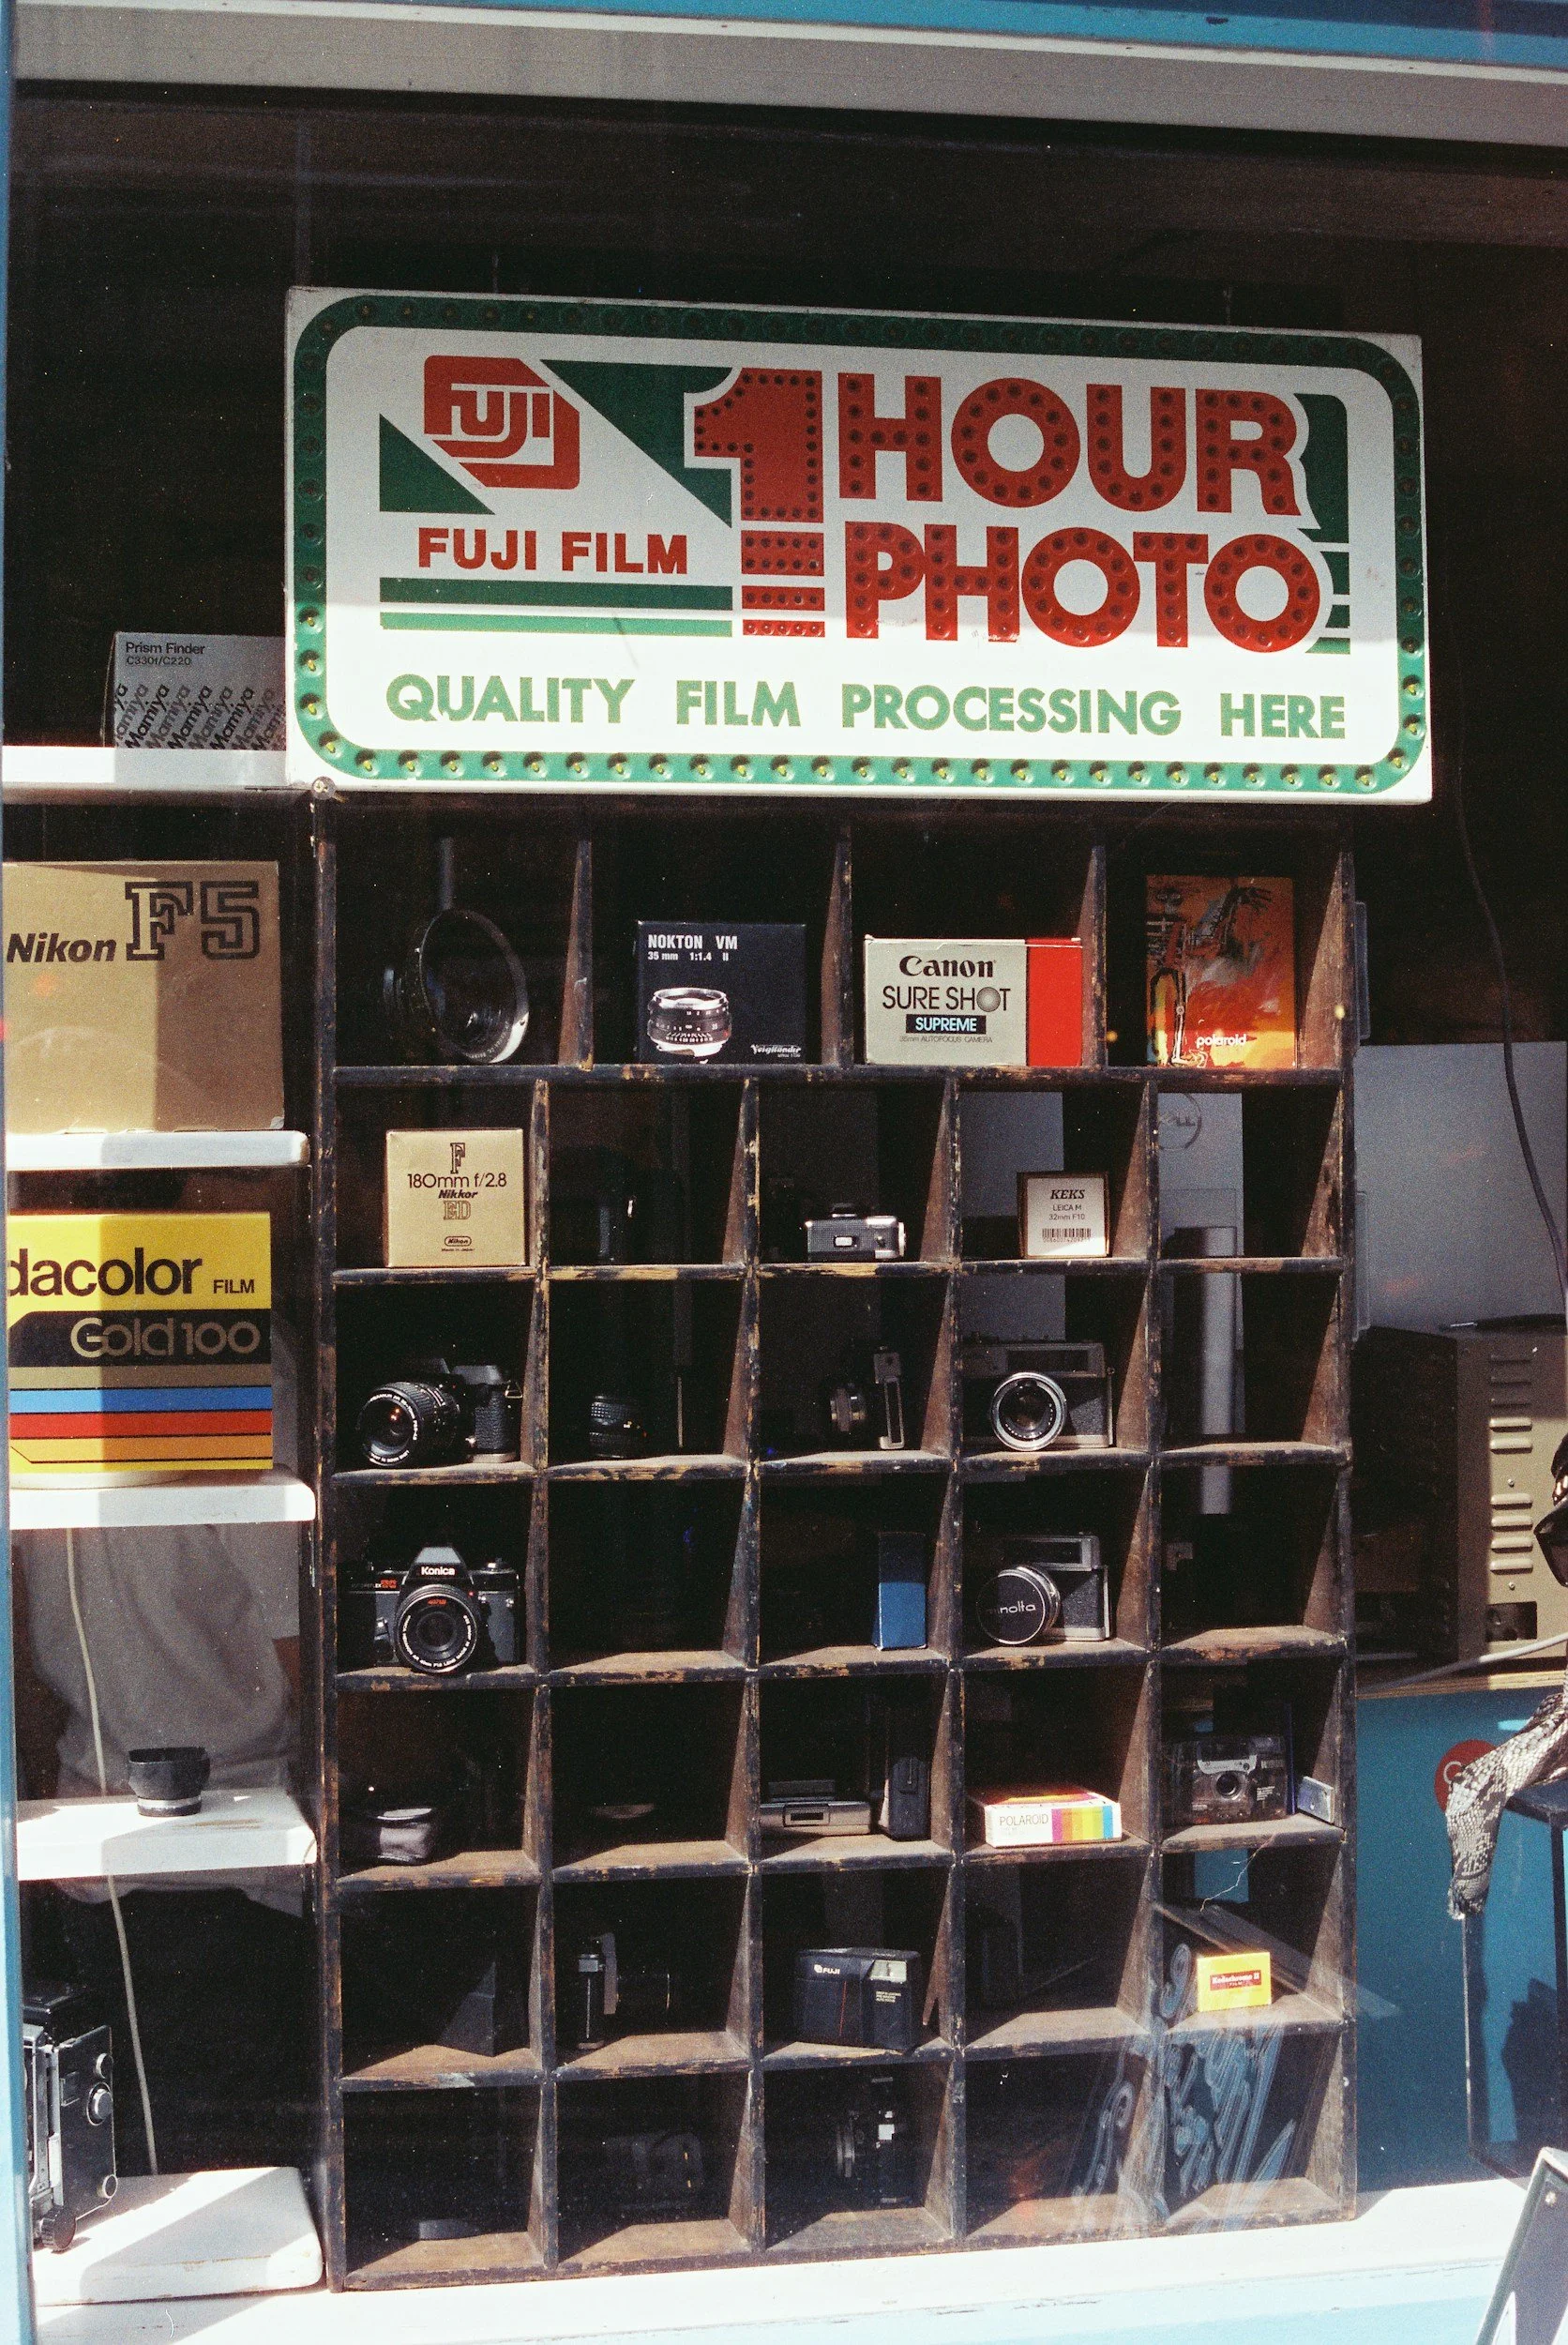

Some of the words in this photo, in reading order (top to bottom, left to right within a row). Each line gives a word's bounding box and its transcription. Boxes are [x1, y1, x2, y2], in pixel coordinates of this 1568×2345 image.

[427, 375, 567, 474] FUJI
[838, 372, 1302, 517] HOUR
[418, 527, 536, 571] FUJI
[561, 531, 687, 575] FILM
[845, 521, 1321, 654] PHOTO
[126, 642, 162, 654] Prism
[166, 642, 205, 654] Finder
[125, 684, 170, 748] Mamiya
[385, 673, 636, 723] QUALITY
[675, 679, 801, 727] FILM
[841, 684, 1182, 736] PROCESSING
[1220, 693, 1346, 740] HERE
[167, 686, 212, 749] Mamiya
[210, 687, 254, 749] Mamiya
[6, 932, 117, 962] Nikon
[125, 881, 261, 961] F5
[647, 934, 702, 949] NOKTON
[716, 935, 738, 950] VM
[647, 951, 659, 961] 35
[661, 952, 679, 961] mm
[689, 952, 713, 961] 1:1.4
[899, 956, 993, 977] Canon
[882, 986, 940, 1009] SURE
[946, 987, 1011, 1012] SHOT
[915, 1017, 977, 1032] SUPREME
[1196, 1033, 1247, 1050] polaroid
[450, 1142, 465, 1174] F
[407, 1173, 470, 1188] 180mm
[475, 1172, 507, 1188] f/2.8
[438, 1189, 478, 1199] Nikkor
[1050, 1189, 1085, 1200] KEKS
[444, 1201, 471, 1220] ED
[213, 1279, 255, 1294] FILM
[70, 1317, 173, 1358] Gold
[421, 1566, 456, 1576] Konica
[999, 1814, 1048, 1827] POLAROID
